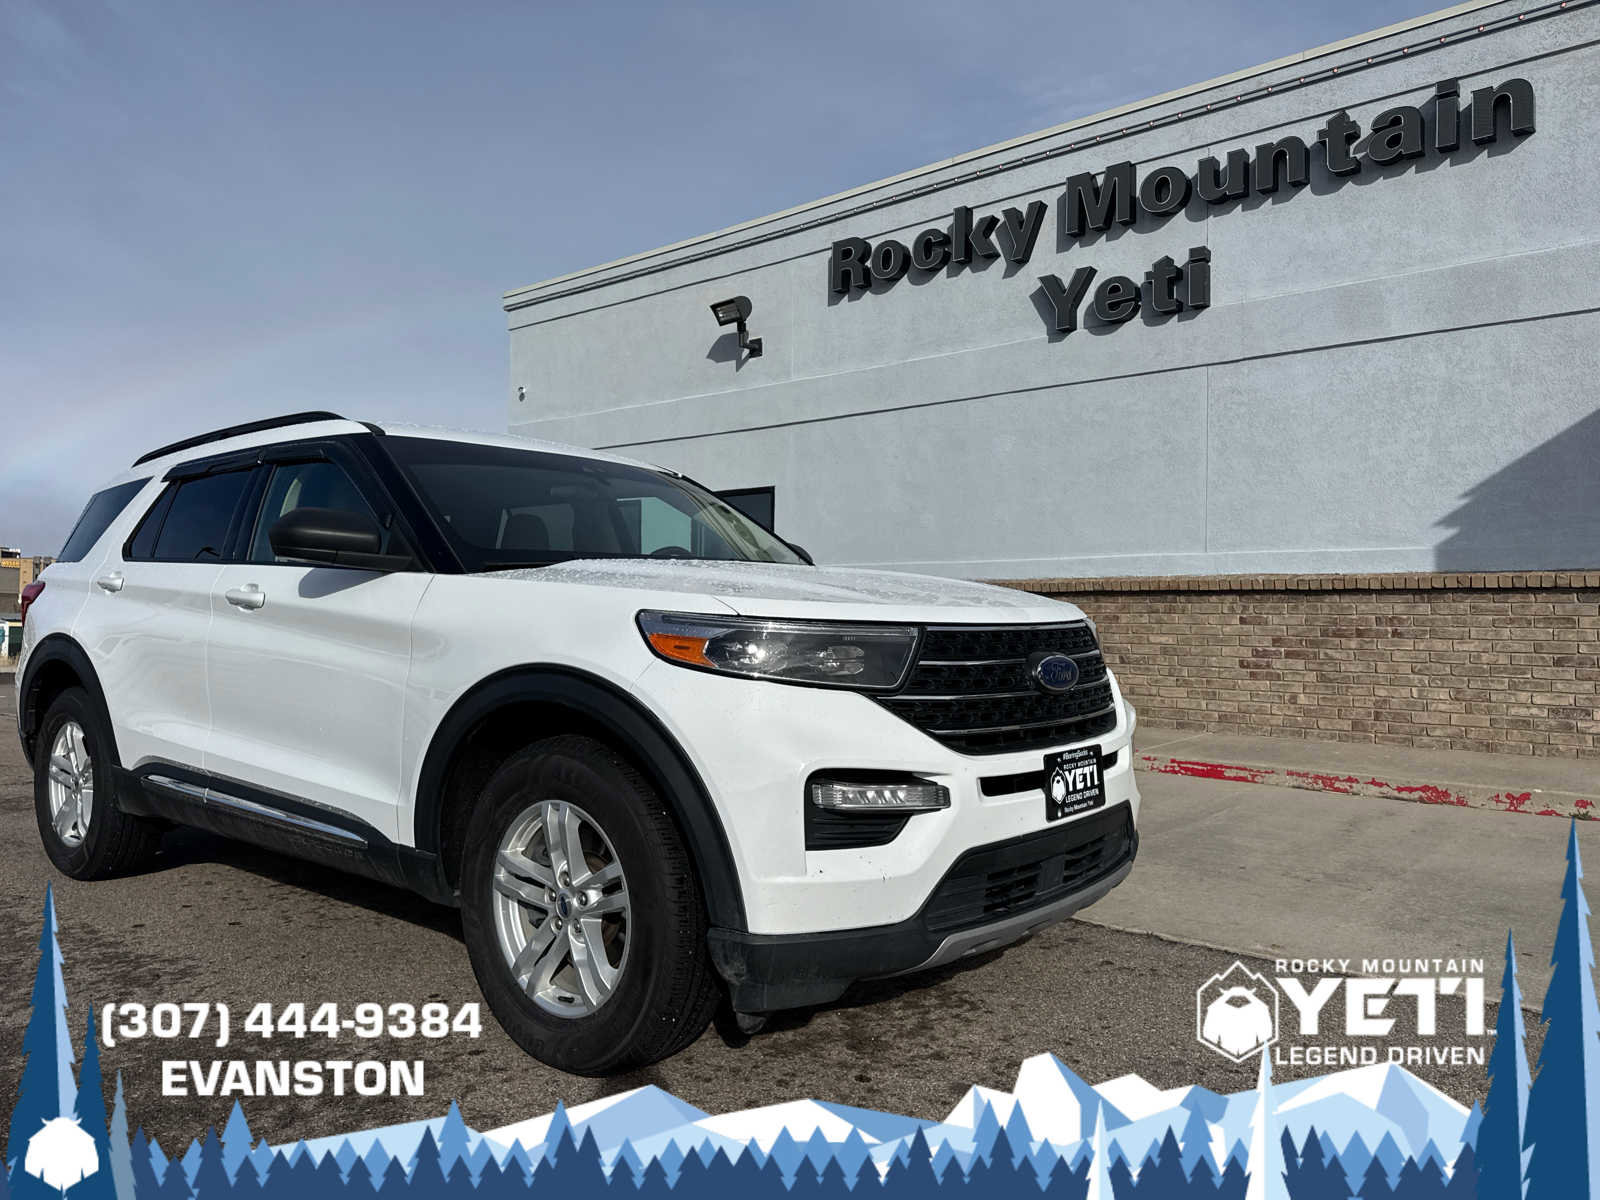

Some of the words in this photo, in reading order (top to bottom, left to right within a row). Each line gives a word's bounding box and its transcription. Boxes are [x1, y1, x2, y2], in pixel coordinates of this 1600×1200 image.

[828, 200, 1047, 295] Rocky
[1063, 77, 1537, 238] Mountain
[1037, 246, 1212, 334] Yeti
[1064, 764, 1098, 791] YETI
[1065, 792, 1083, 803] LEGEND
[1083, 788, 1099, 799] DRIVEN
